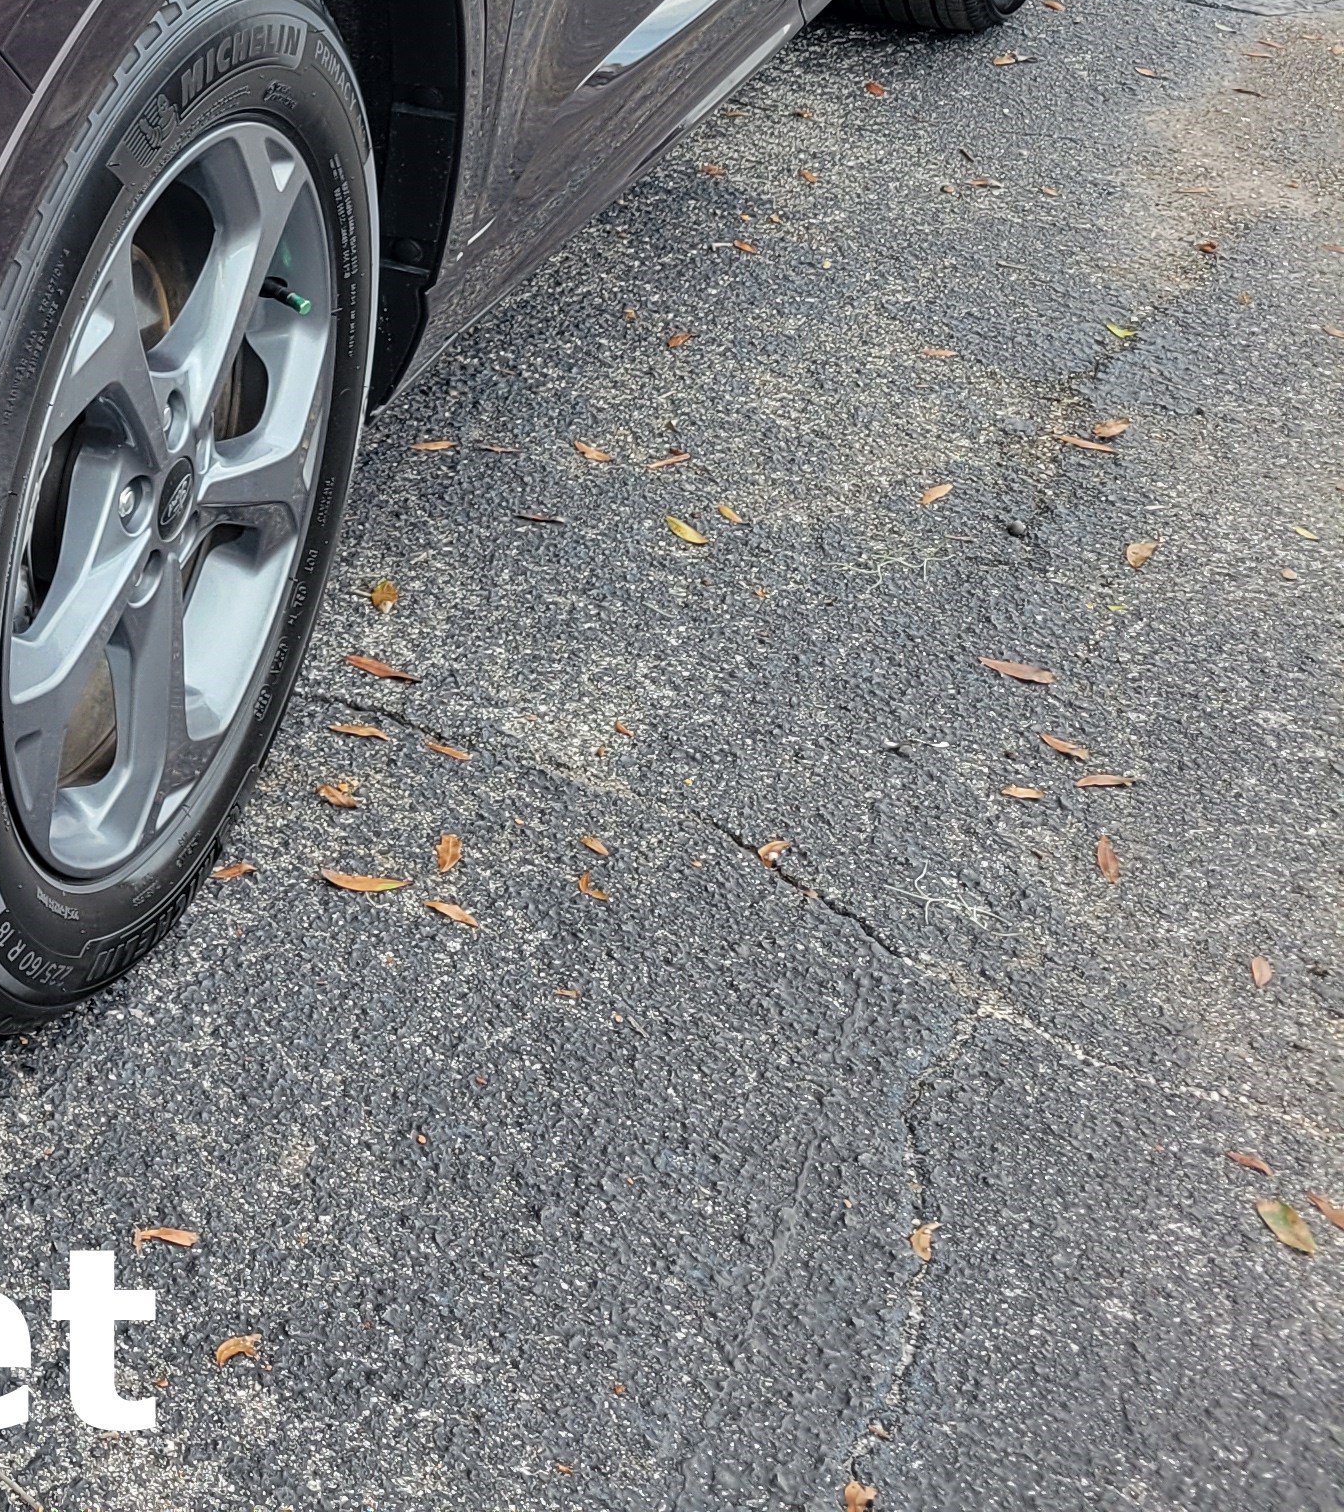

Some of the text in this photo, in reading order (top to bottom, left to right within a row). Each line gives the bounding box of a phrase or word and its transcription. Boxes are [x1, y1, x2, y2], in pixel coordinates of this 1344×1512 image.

[180, 24, 301, 108] MICHELIN
[314, 39, 358, 111] PRIMACY
[9, 940, 27, 963] R
